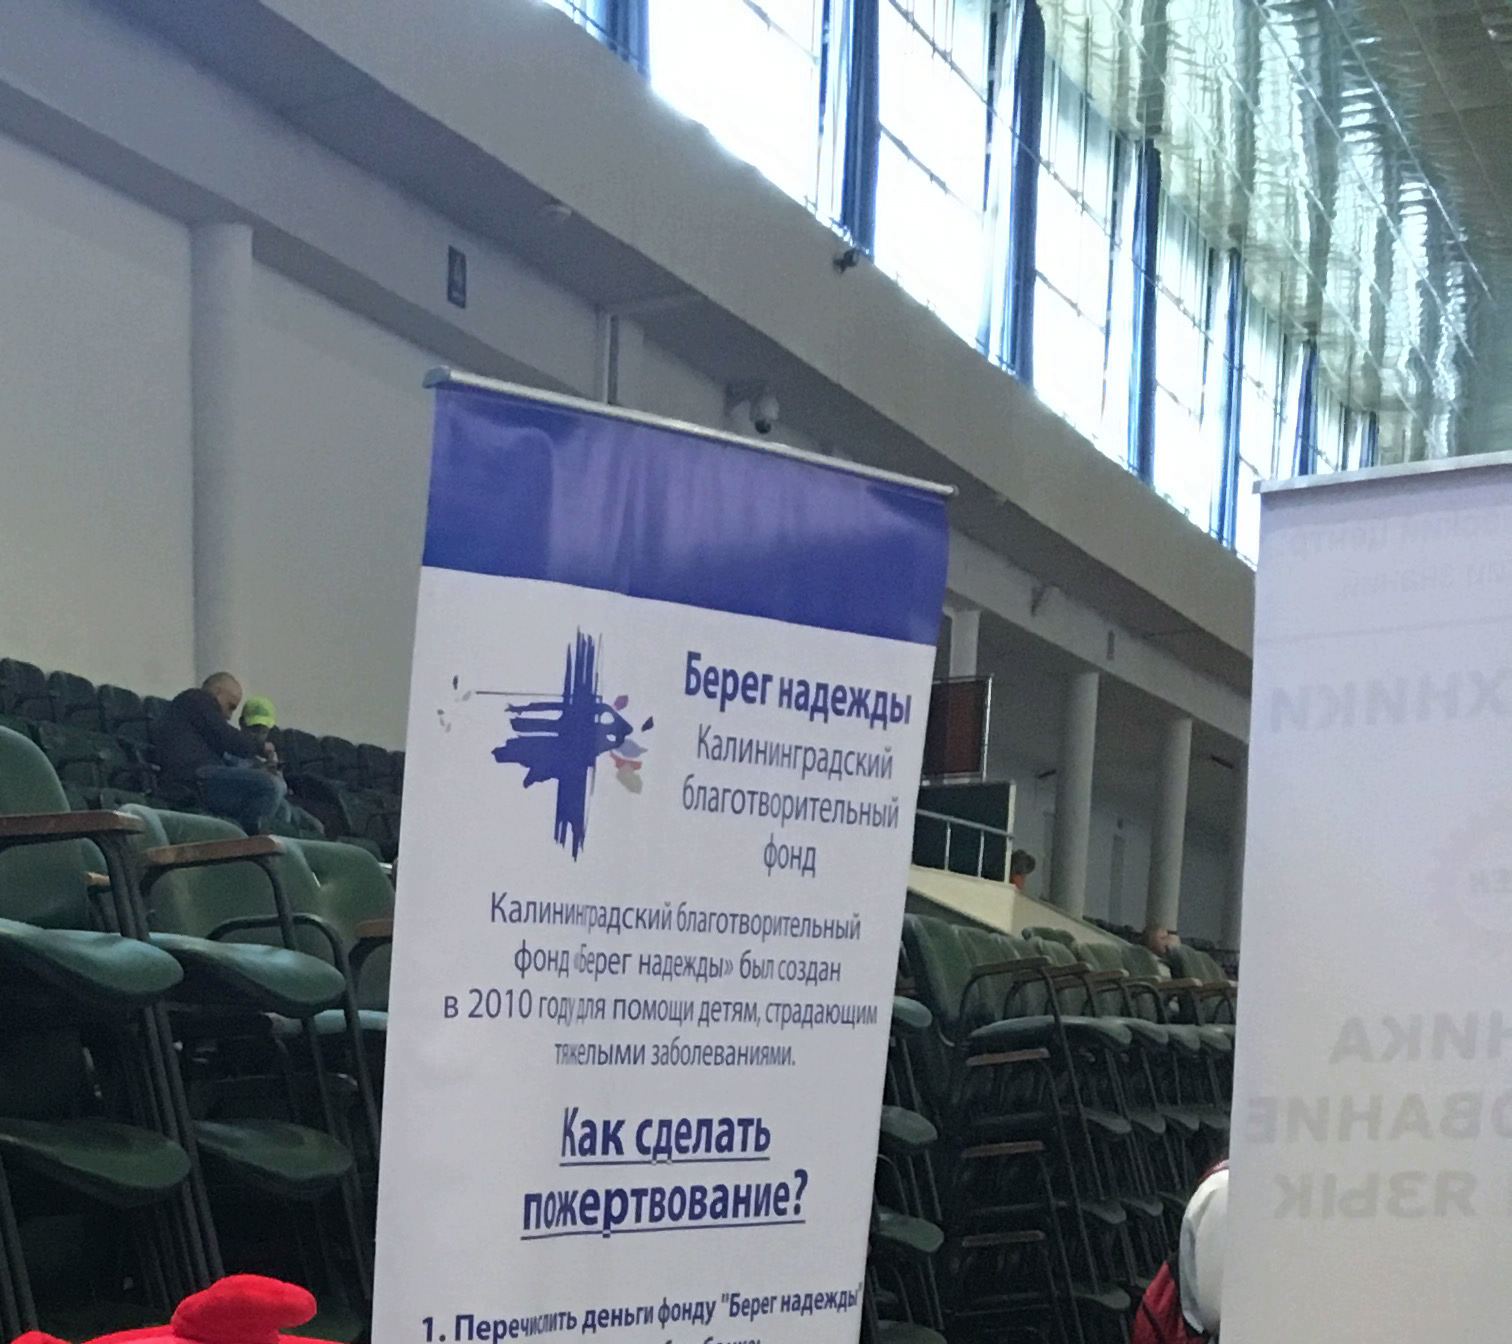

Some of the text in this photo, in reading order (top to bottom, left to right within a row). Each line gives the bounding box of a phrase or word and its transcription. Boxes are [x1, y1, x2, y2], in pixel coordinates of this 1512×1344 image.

[684, 650, 912, 731] Берег надежды
[697, 723, 893, 781] Калининградский
[682, 773, 900, 829] благотворительный
[763, 832, 817, 878] фонд
[490, 891, 861, 941] Калининградский благотворительный
[513, 939, 570, 979] фонд
[638, 952, 734, 980] надежды»
[739, 949, 774, 980] был
[777, 957, 842, 987] создан
[443, 988, 878, 1029] в 2010 году для помощи детям, страдающим
[554, 1036, 796, 1067] тяжелыми заболеваниями.
[561, 1106, 772, 1163] Как сделать
[522, 1168, 809, 1237] пожертвование?
[421, 1316, 447, 1343] 1.
[581, 1306, 654, 1334] деньги
[657, 1297, 717, 1329] фонду
[720, 1292, 776, 1322] "Берег
